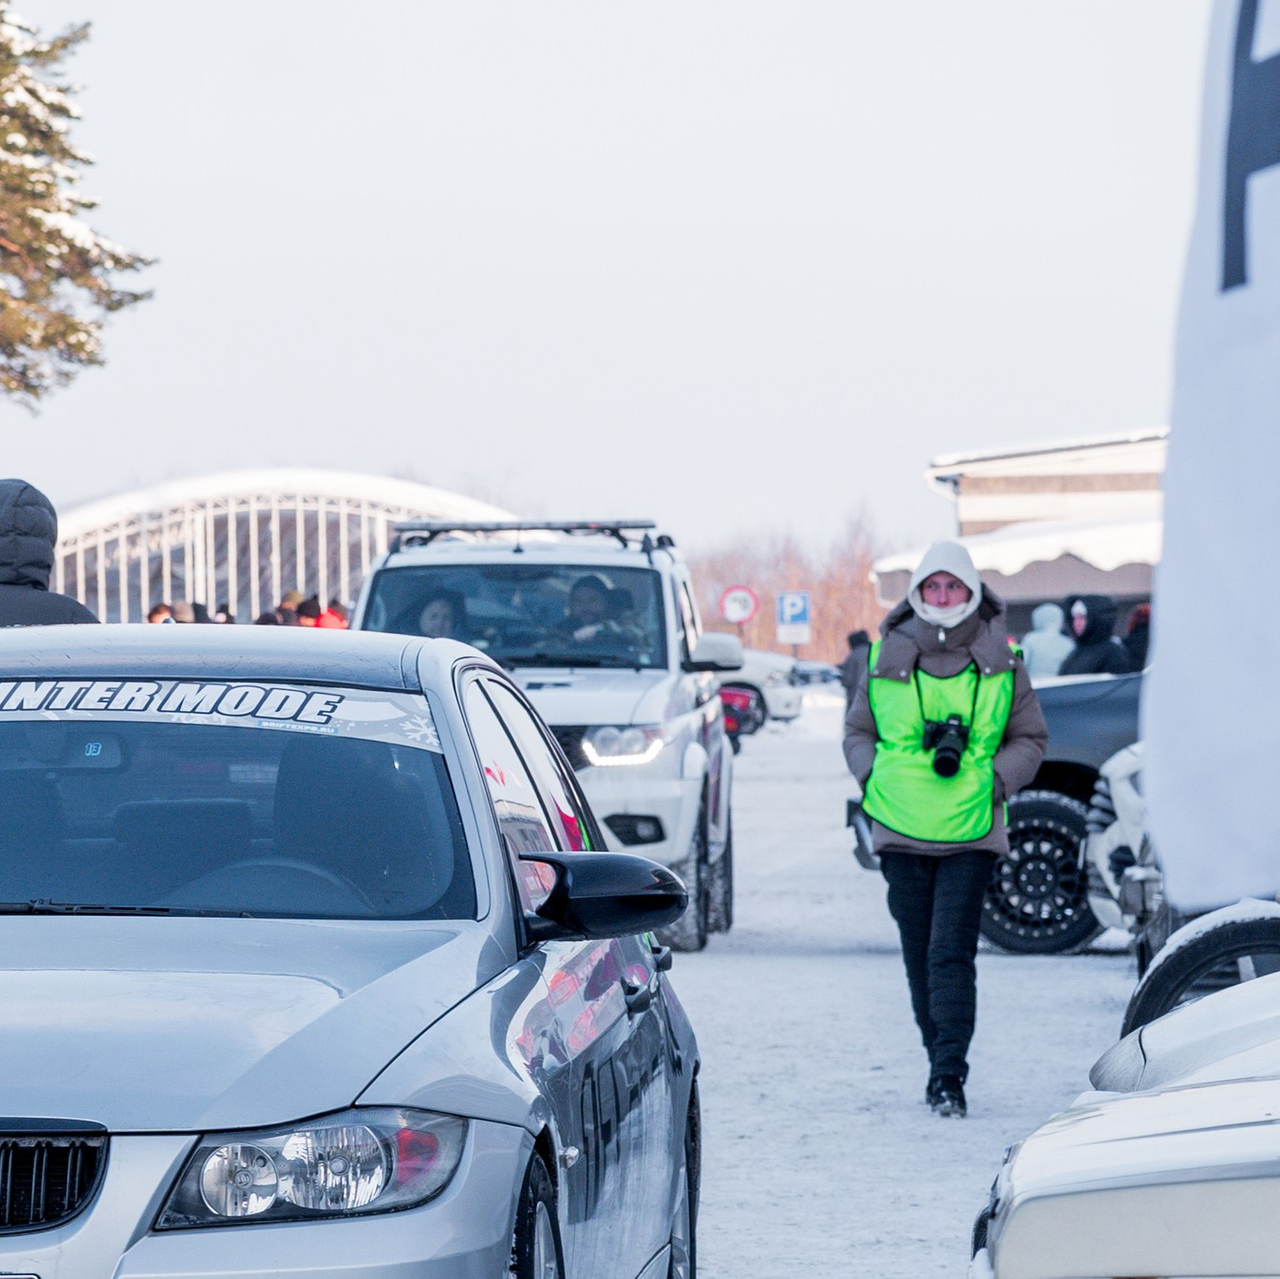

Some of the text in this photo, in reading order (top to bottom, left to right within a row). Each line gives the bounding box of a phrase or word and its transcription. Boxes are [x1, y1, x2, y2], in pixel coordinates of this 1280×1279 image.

[159, 682, 344, 724] MODE
[261, 721, 335, 733] DRIFTEXPO.RU
[85, 742, 102, 756] 13
